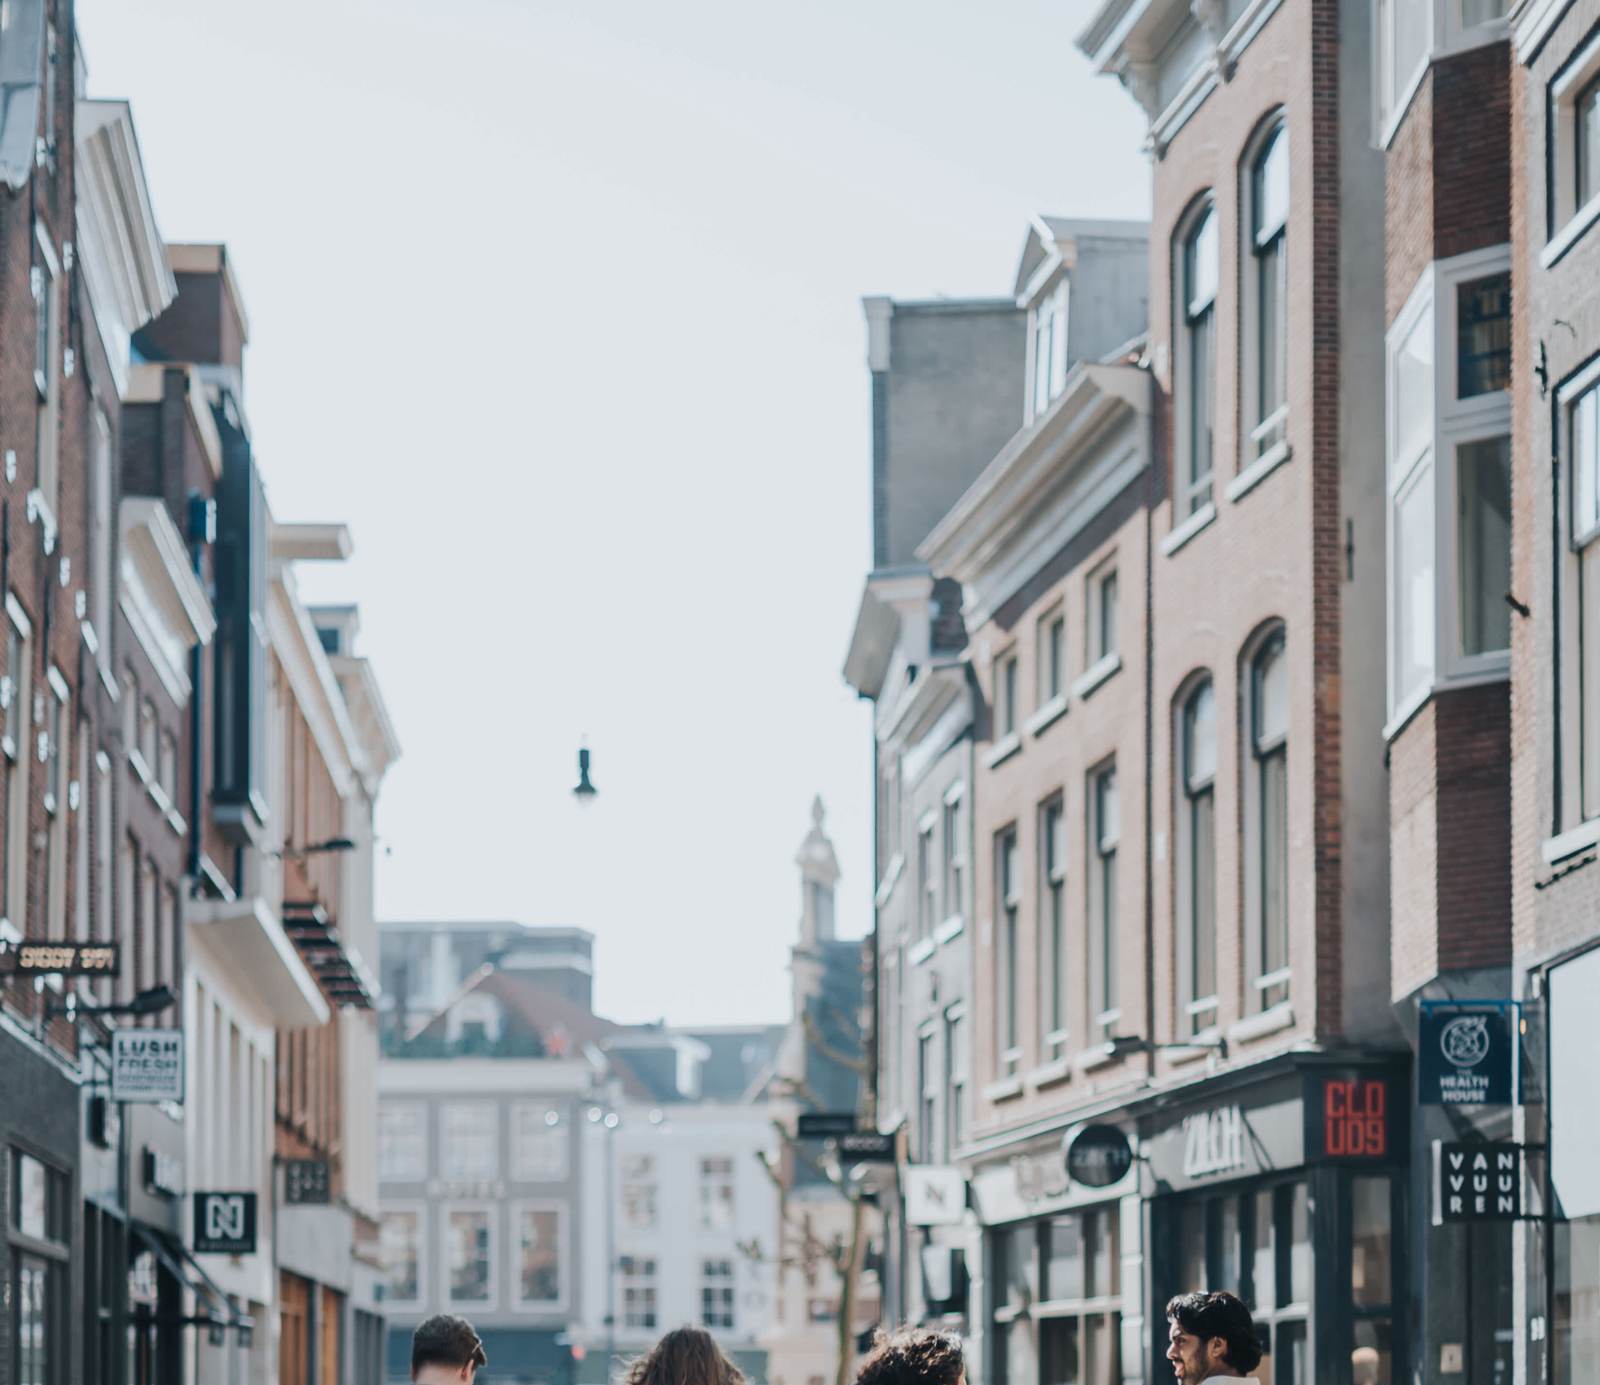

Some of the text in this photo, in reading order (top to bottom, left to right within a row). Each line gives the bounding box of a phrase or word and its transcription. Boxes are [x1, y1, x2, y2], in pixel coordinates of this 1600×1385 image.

[119, 1040, 177, 1056] LUSH
[1440, 1076, 1489, 1088] HEALTH
[1442, 1089, 1485, 1102] HOUSE
[1449, 1152, 1513, 1170] VAN
[1449, 1174, 1513, 1192] VUU
[1450, 1195, 1513, 1213] REN
